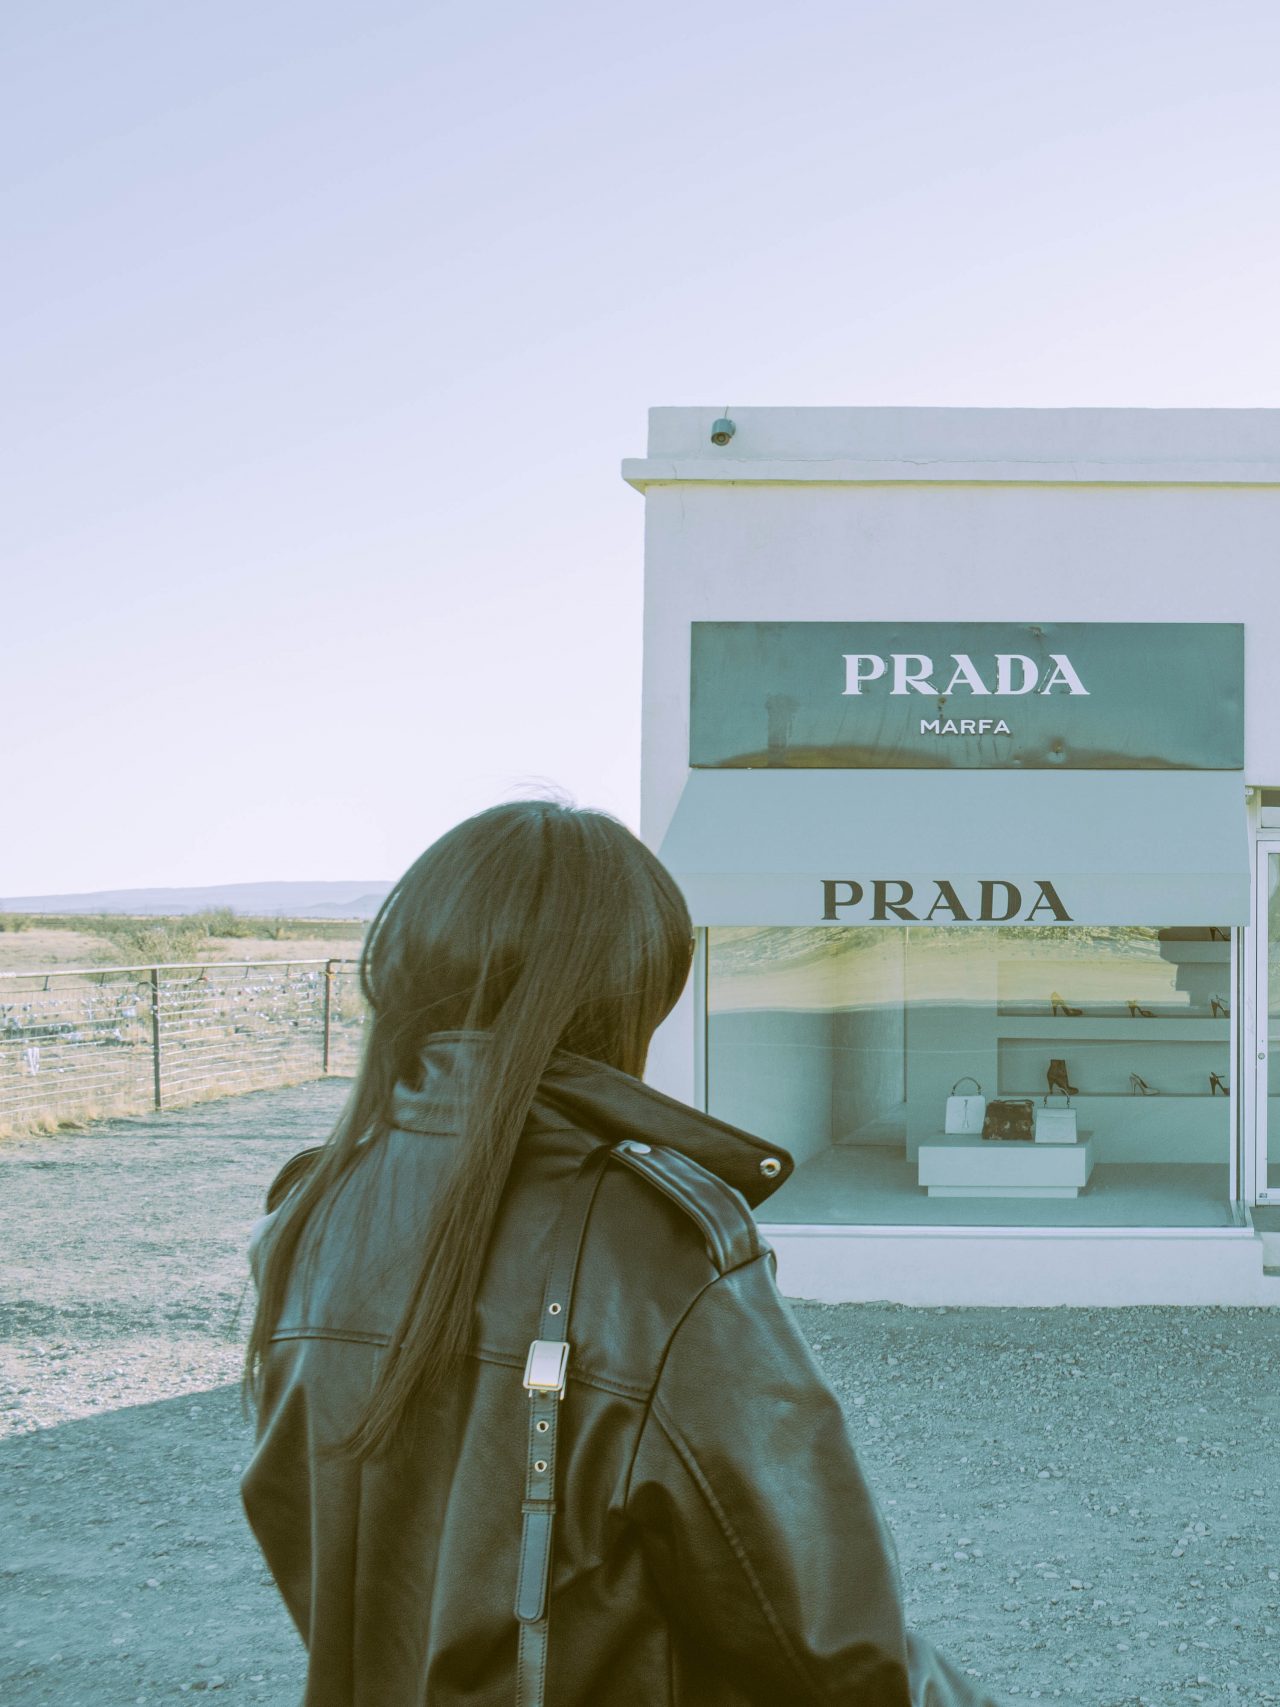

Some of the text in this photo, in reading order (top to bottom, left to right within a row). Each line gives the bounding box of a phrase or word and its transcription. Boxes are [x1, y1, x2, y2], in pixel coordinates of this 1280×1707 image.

[842, 653, 1091, 696] PRADA
[919, 718, 1012, 736] MARFA
[820, 879, 1074, 922] PRADA
